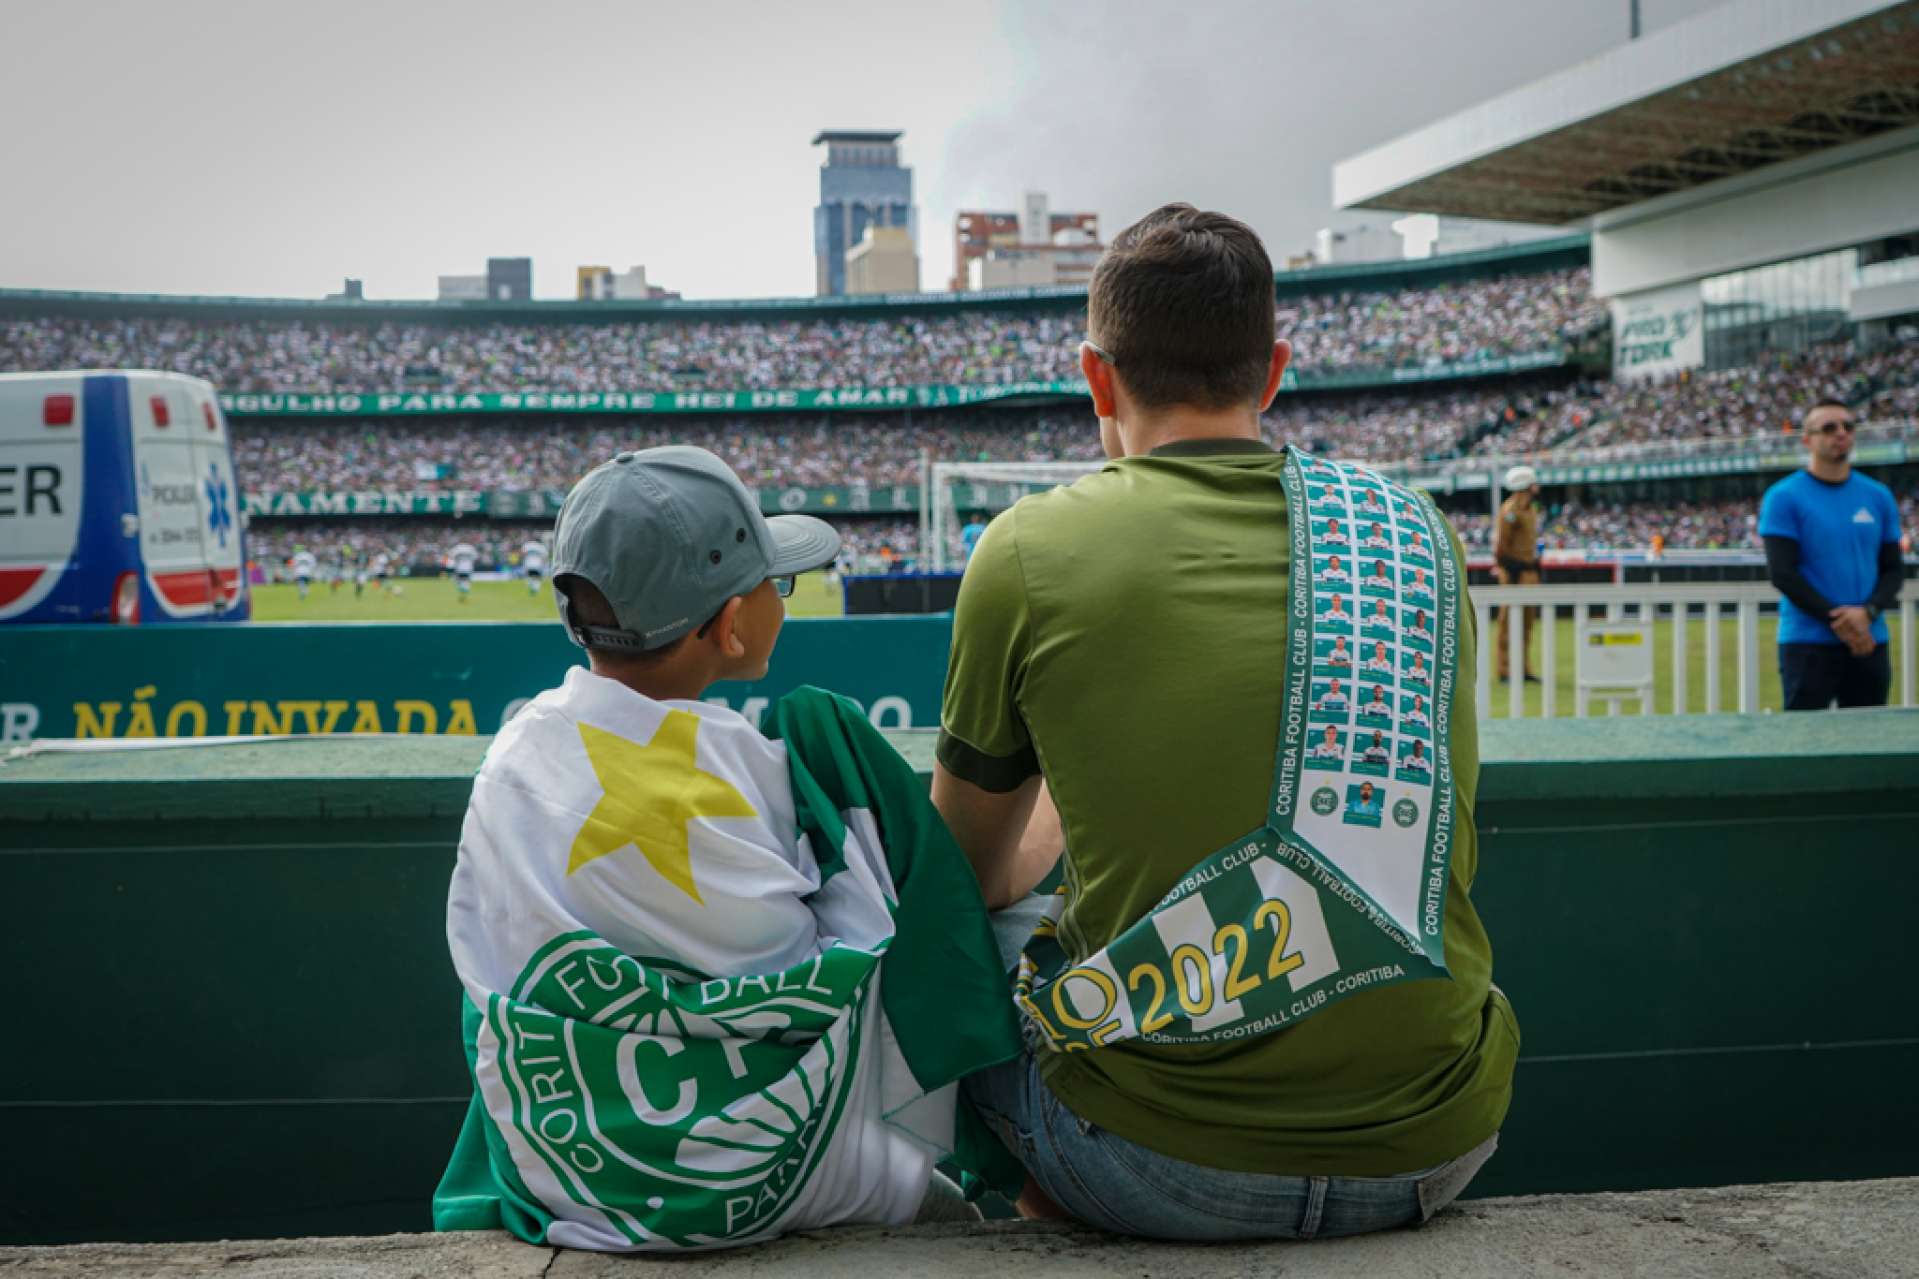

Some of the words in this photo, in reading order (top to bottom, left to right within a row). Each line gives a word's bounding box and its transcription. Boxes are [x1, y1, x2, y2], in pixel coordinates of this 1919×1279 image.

[378, 392, 484, 411] PARA
[500, 392, 656, 409] SEMPRE
[674, 392, 736, 409] HEI
[751, 391, 798, 408] DE
[814, 388, 908, 406] AMAR
[1294, 495, 1306, 556] FOOTBALL
[1294, 559, 1307, 617] CORITIBA
[1441, 558, 1456, 591] CLUB
[1293, 629, 1307, 666] CLUB
[1441, 595, 1457, 666] FOOTBALL
[73, 685, 208, 739] NÃO
[224, 700, 478, 737] INVADA
[1286, 669, 1305, 747] FOOTBALL
[1437, 669, 1454, 735] CORITIBA
[1276, 748, 1298, 817] CORITIBA
[1438, 746, 1451, 782] CLUB
[1277, 842, 1311, 869] CLUB
[1432, 787, 1451, 864] FOOTBALL
[1160, 864, 1223, 906] OOTBALL
[1222, 842, 1260, 872] CLUB
[1311, 863, 1368, 913] FOOTBALL
[1425, 867, 1444, 936] CORITIBA
[1128, 899, 1304, 1034] 2022
[1213, 1009, 1290, 1040] FOOTBALL
[1290, 989, 1327, 1017] CLUB
[1335, 964, 1406, 994] CORITIBA
